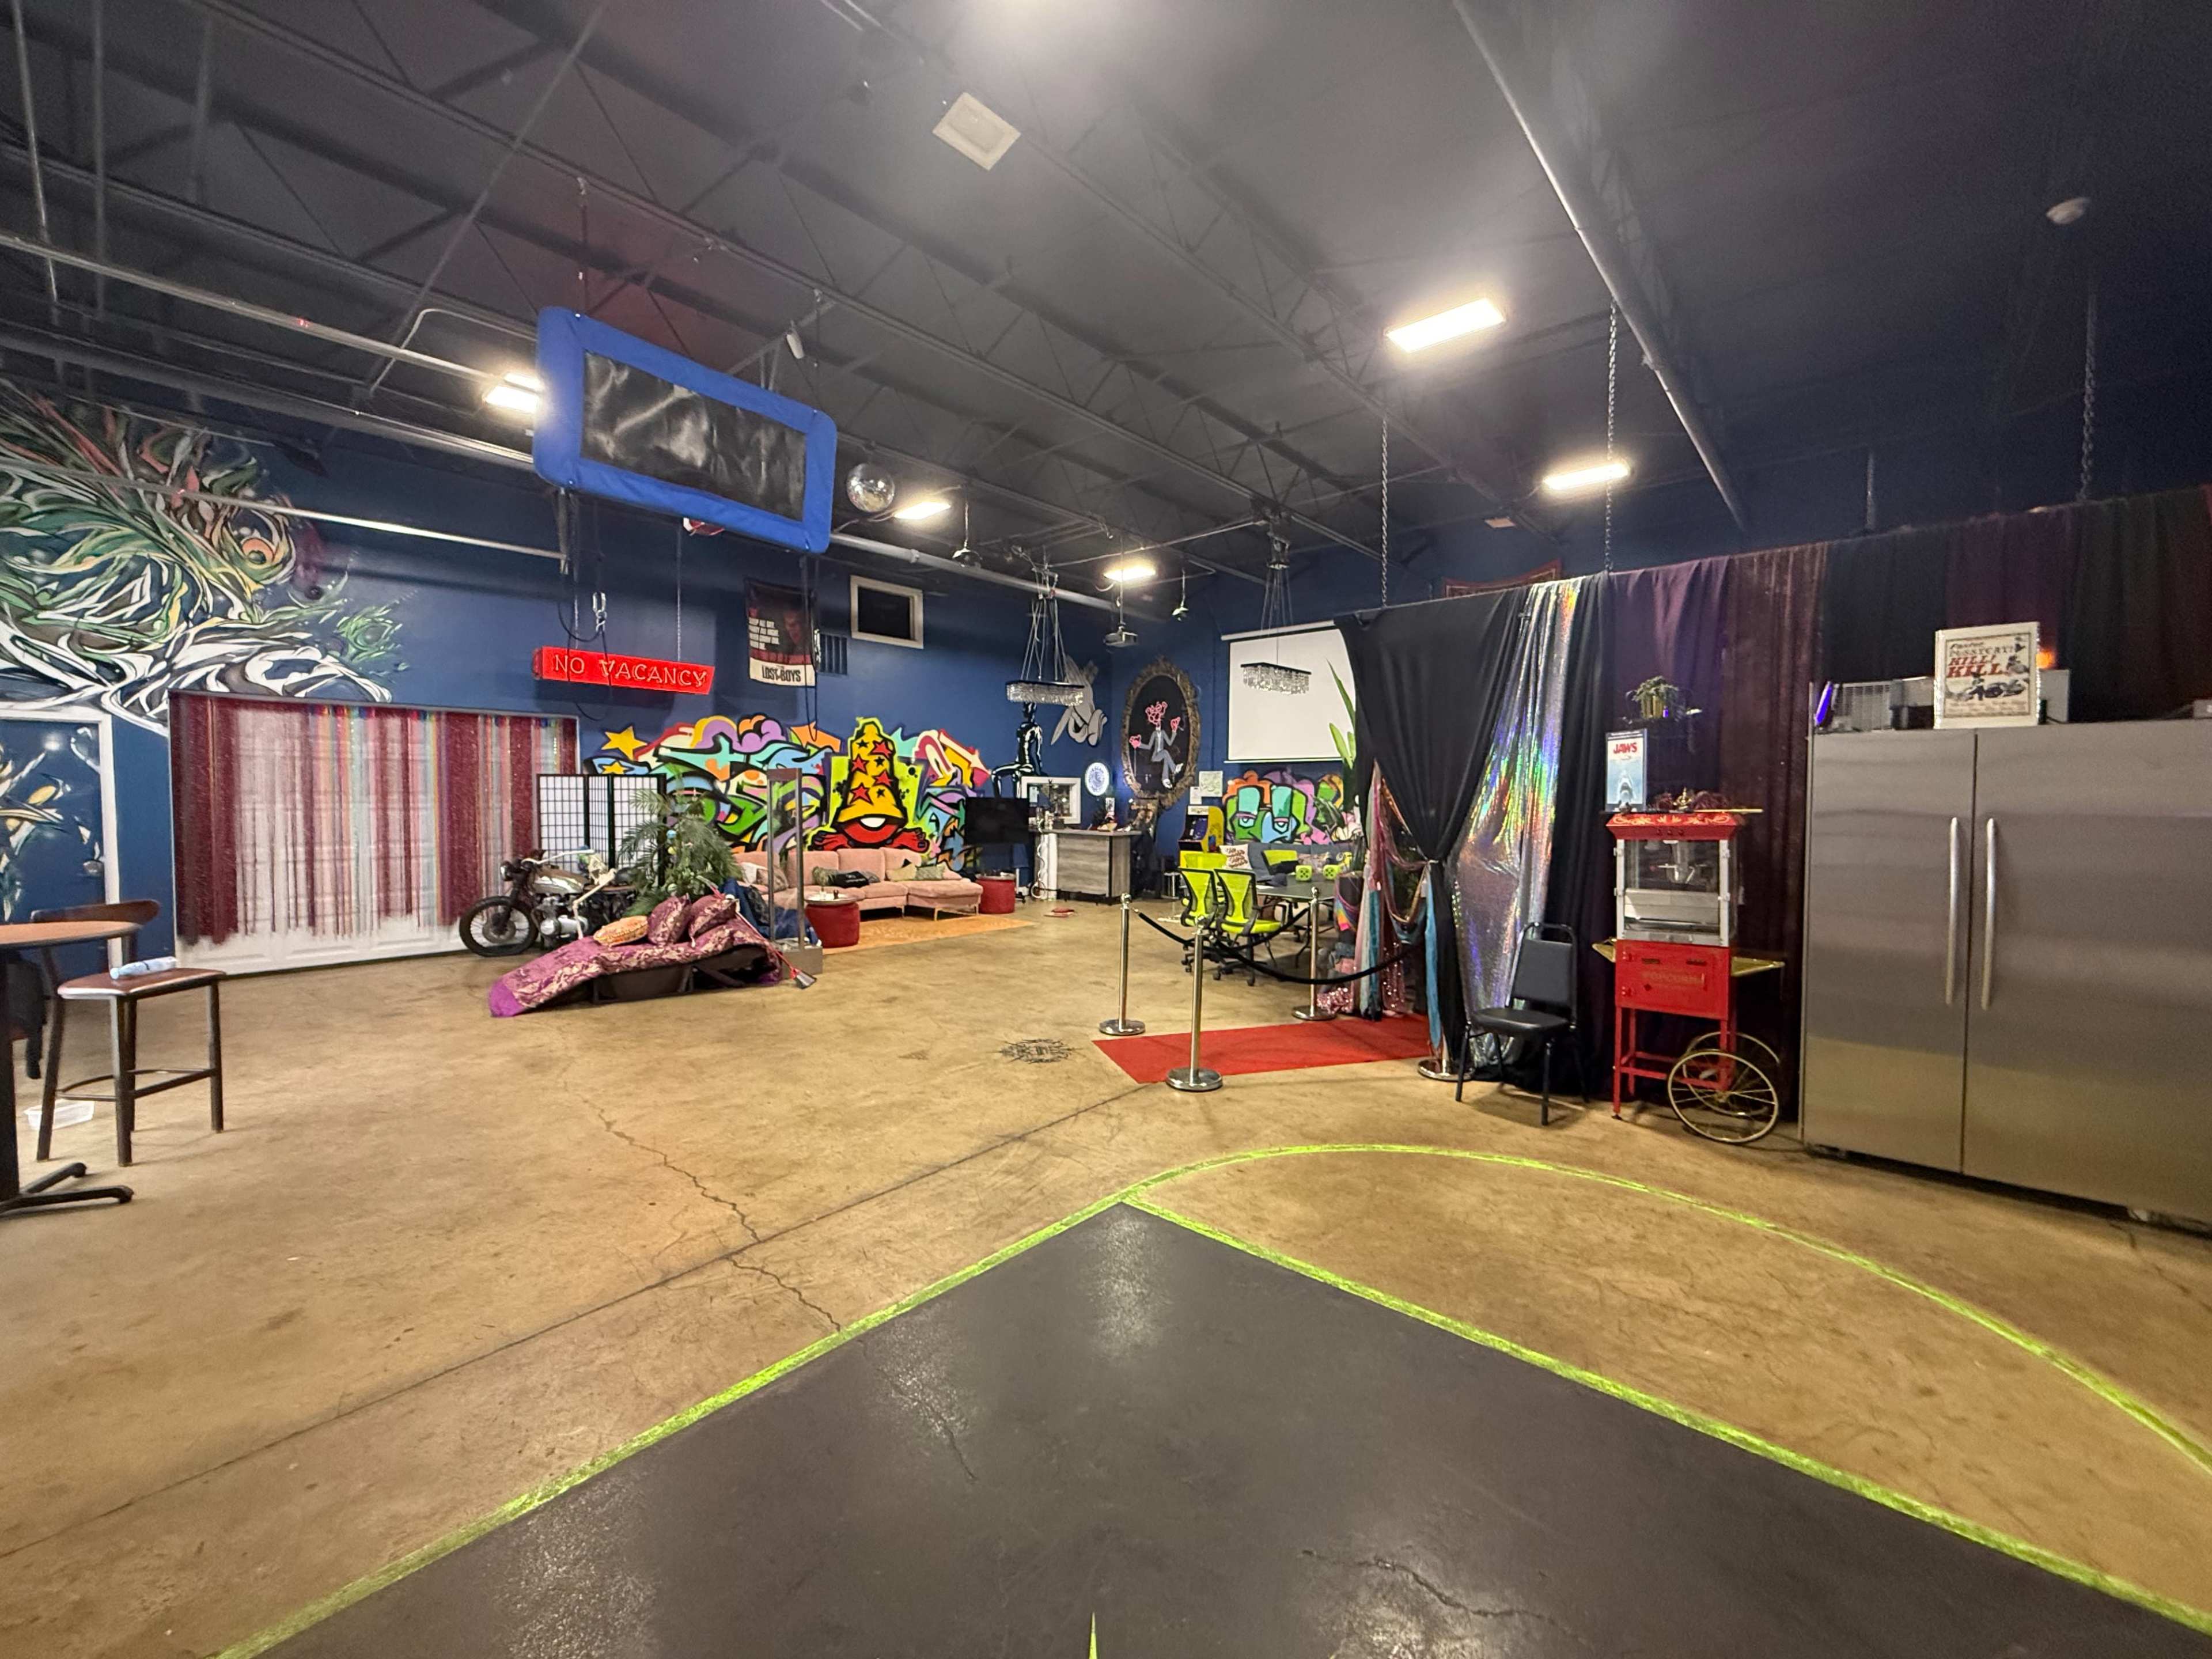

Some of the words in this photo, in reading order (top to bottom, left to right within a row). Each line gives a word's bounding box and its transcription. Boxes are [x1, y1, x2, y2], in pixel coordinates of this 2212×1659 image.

[554, 654, 585, 674] NO
[599, 659, 708, 687] VACANCY
[762, 665, 778, 680] LOST
[779, 669, 801, 682] BOYS
[1613, 742, 1638, 755] JAWS
